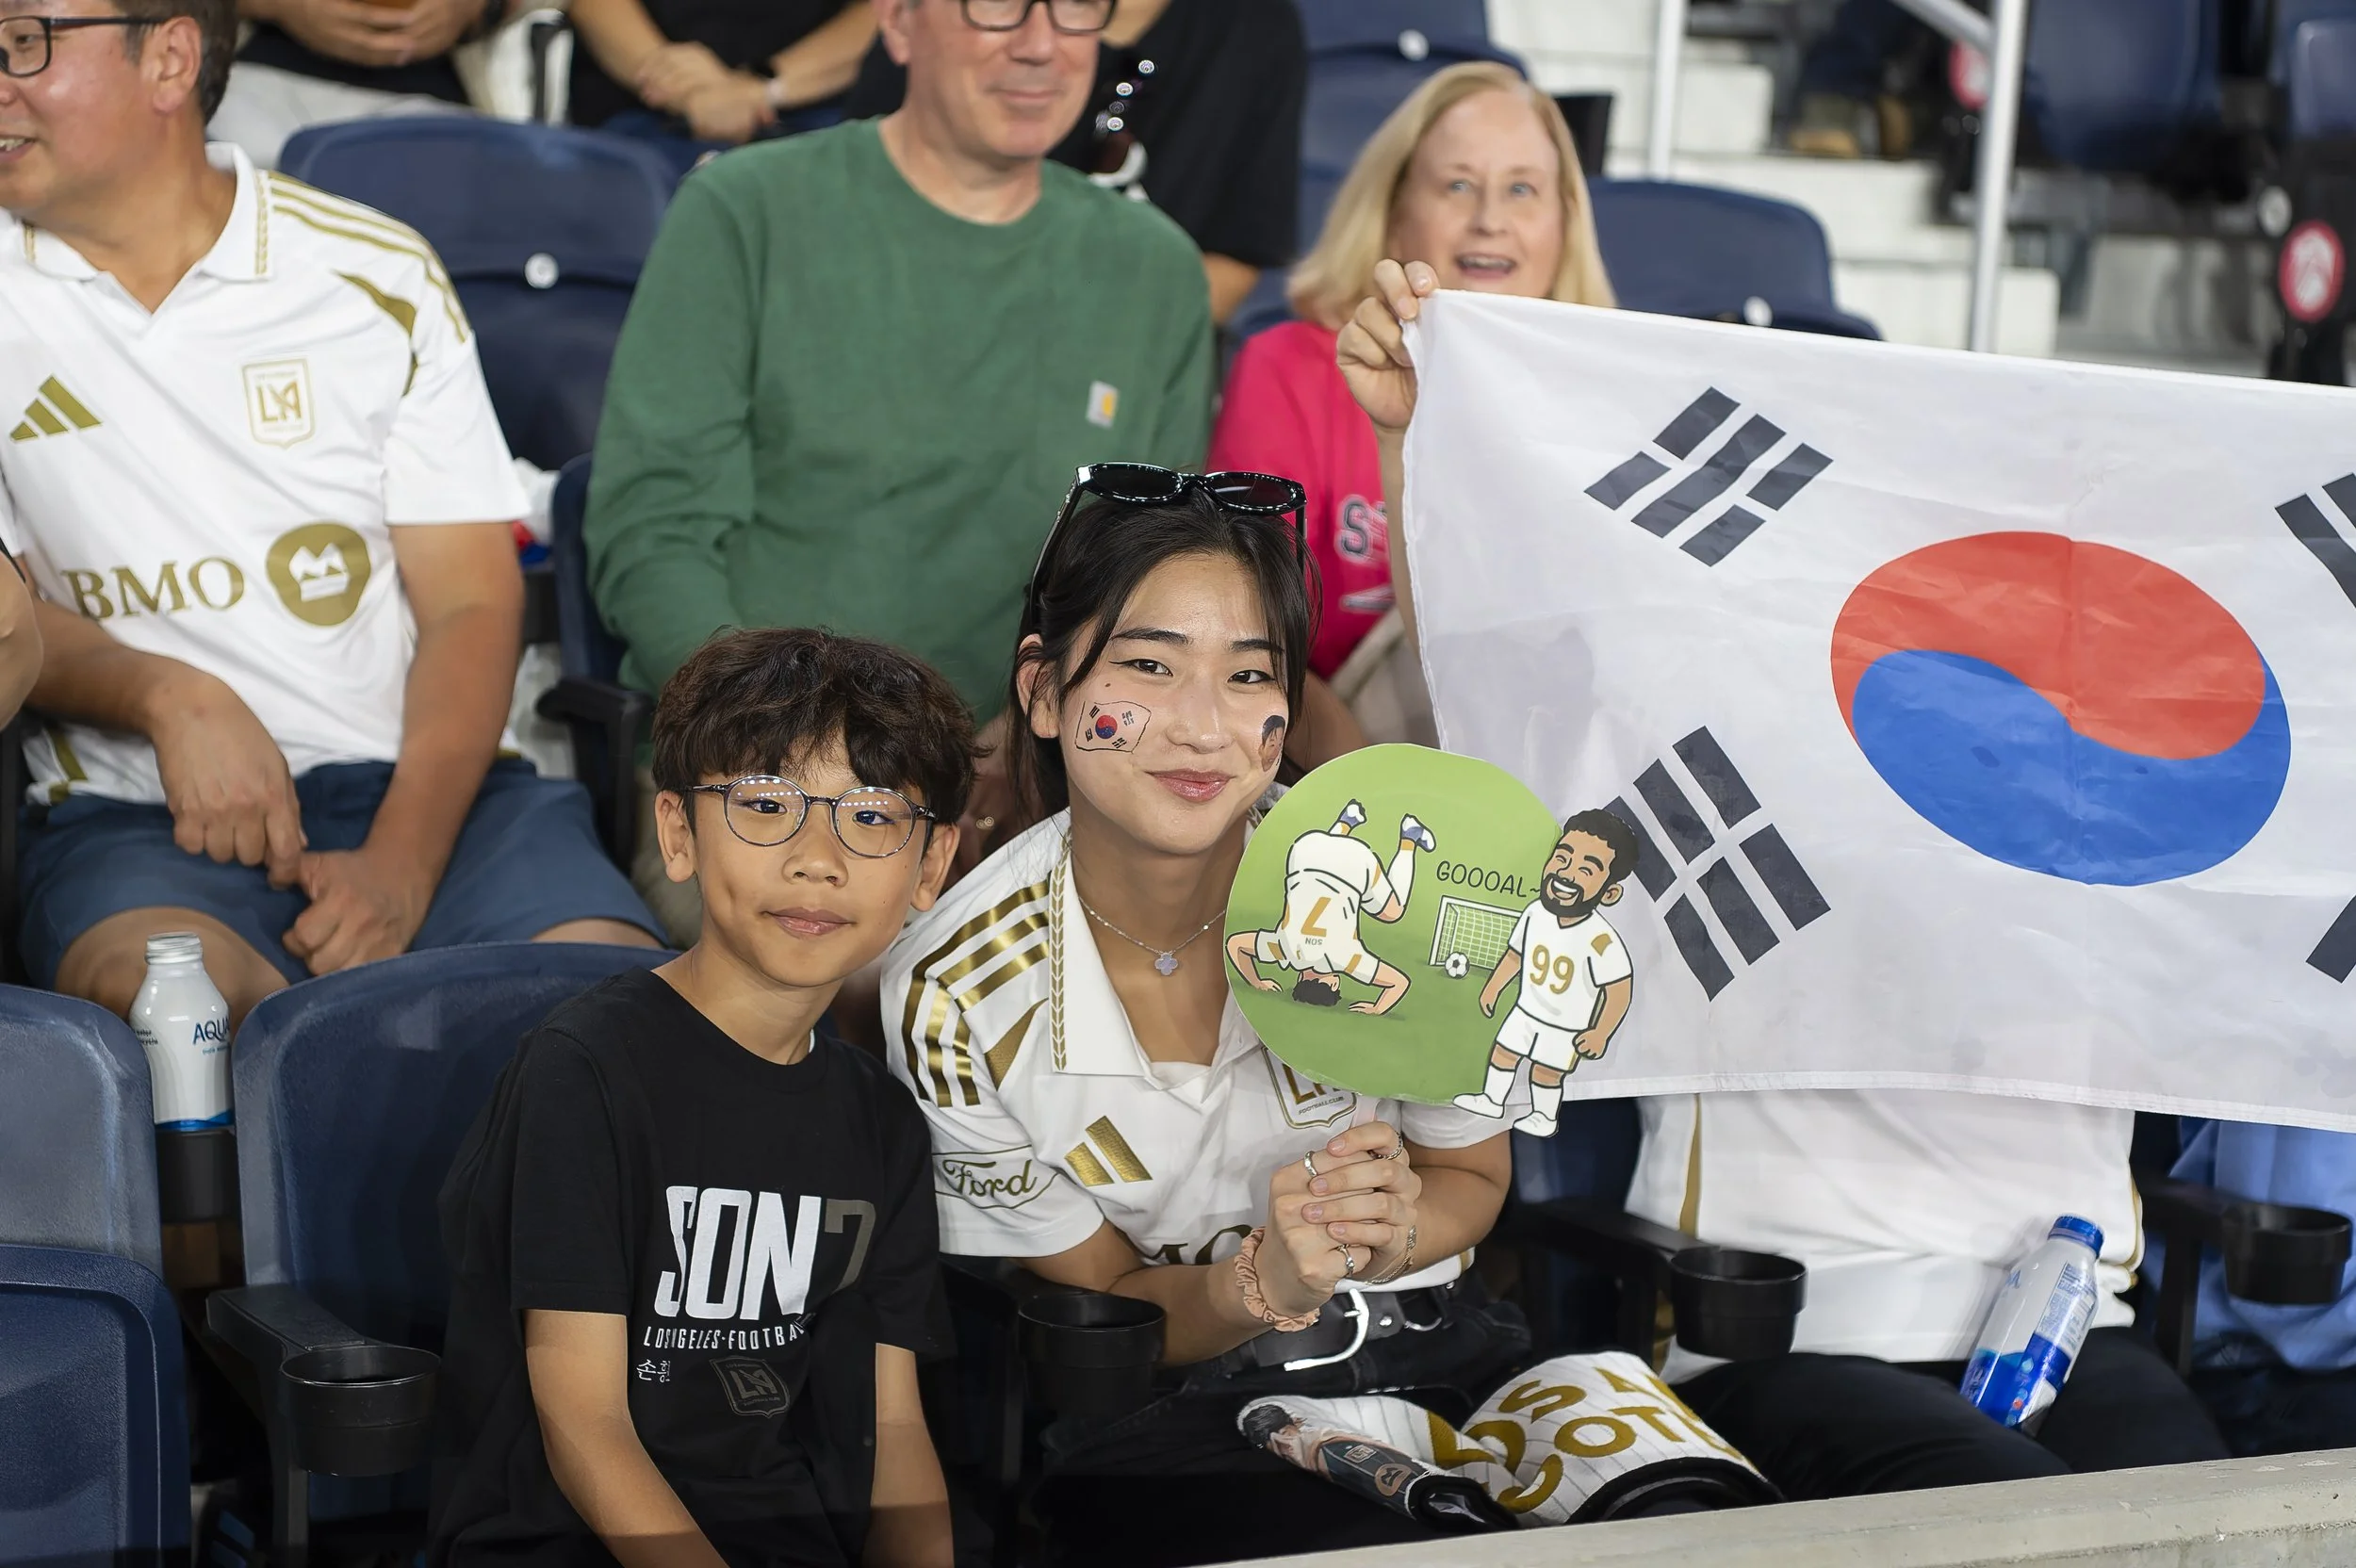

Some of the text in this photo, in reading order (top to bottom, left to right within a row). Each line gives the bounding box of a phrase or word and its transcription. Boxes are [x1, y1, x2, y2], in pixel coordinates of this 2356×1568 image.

[60, 556, 245, 621] BMO
[1530, 944, 1575, 995] 99
[942, 1159, 1038, 1199] Ford
